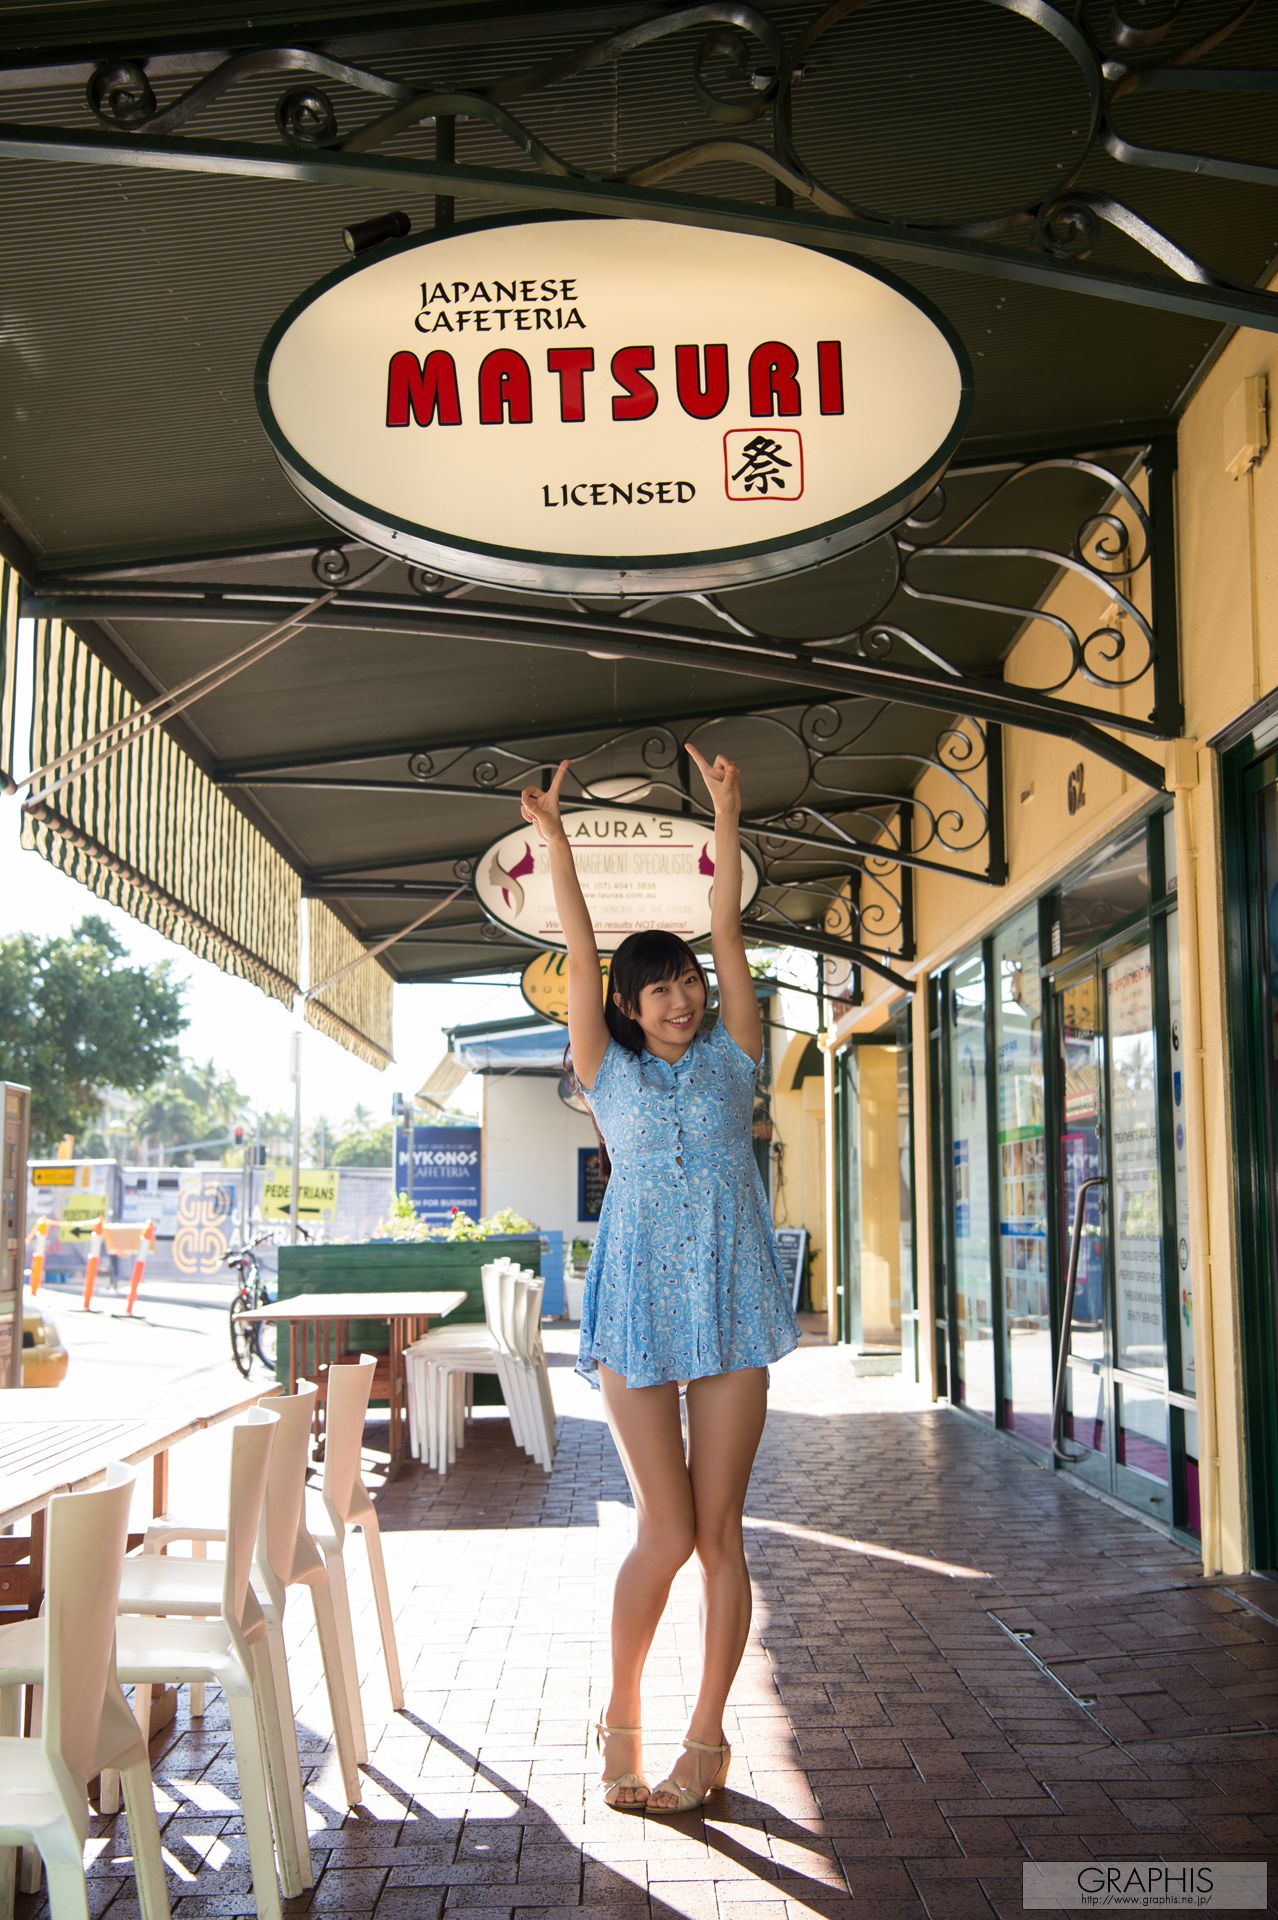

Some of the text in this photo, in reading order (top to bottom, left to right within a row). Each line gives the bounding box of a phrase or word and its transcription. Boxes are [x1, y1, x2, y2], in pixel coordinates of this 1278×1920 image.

[420, 278, 579, 310] JAPANESE
[414, 307, 587, 334] CAFETERIA
[386, 341, 845, 427] MATSURI
[731, 435, 793, 495] 祭
[541, 480, 697, 508] LICENSED
[1067, 762, 1086, 816] 62
[634, 853, 693, 875] SPECIALISTS
[584, 891, 657, 900] ww.lauras.com.au
[604, 920, 633, 929] results
[635, 920, 655, 929] NOT
[398, 1150, 478, 1166] MYKONOS
[264, 1184, 335, 1200] PEDETRIANS
